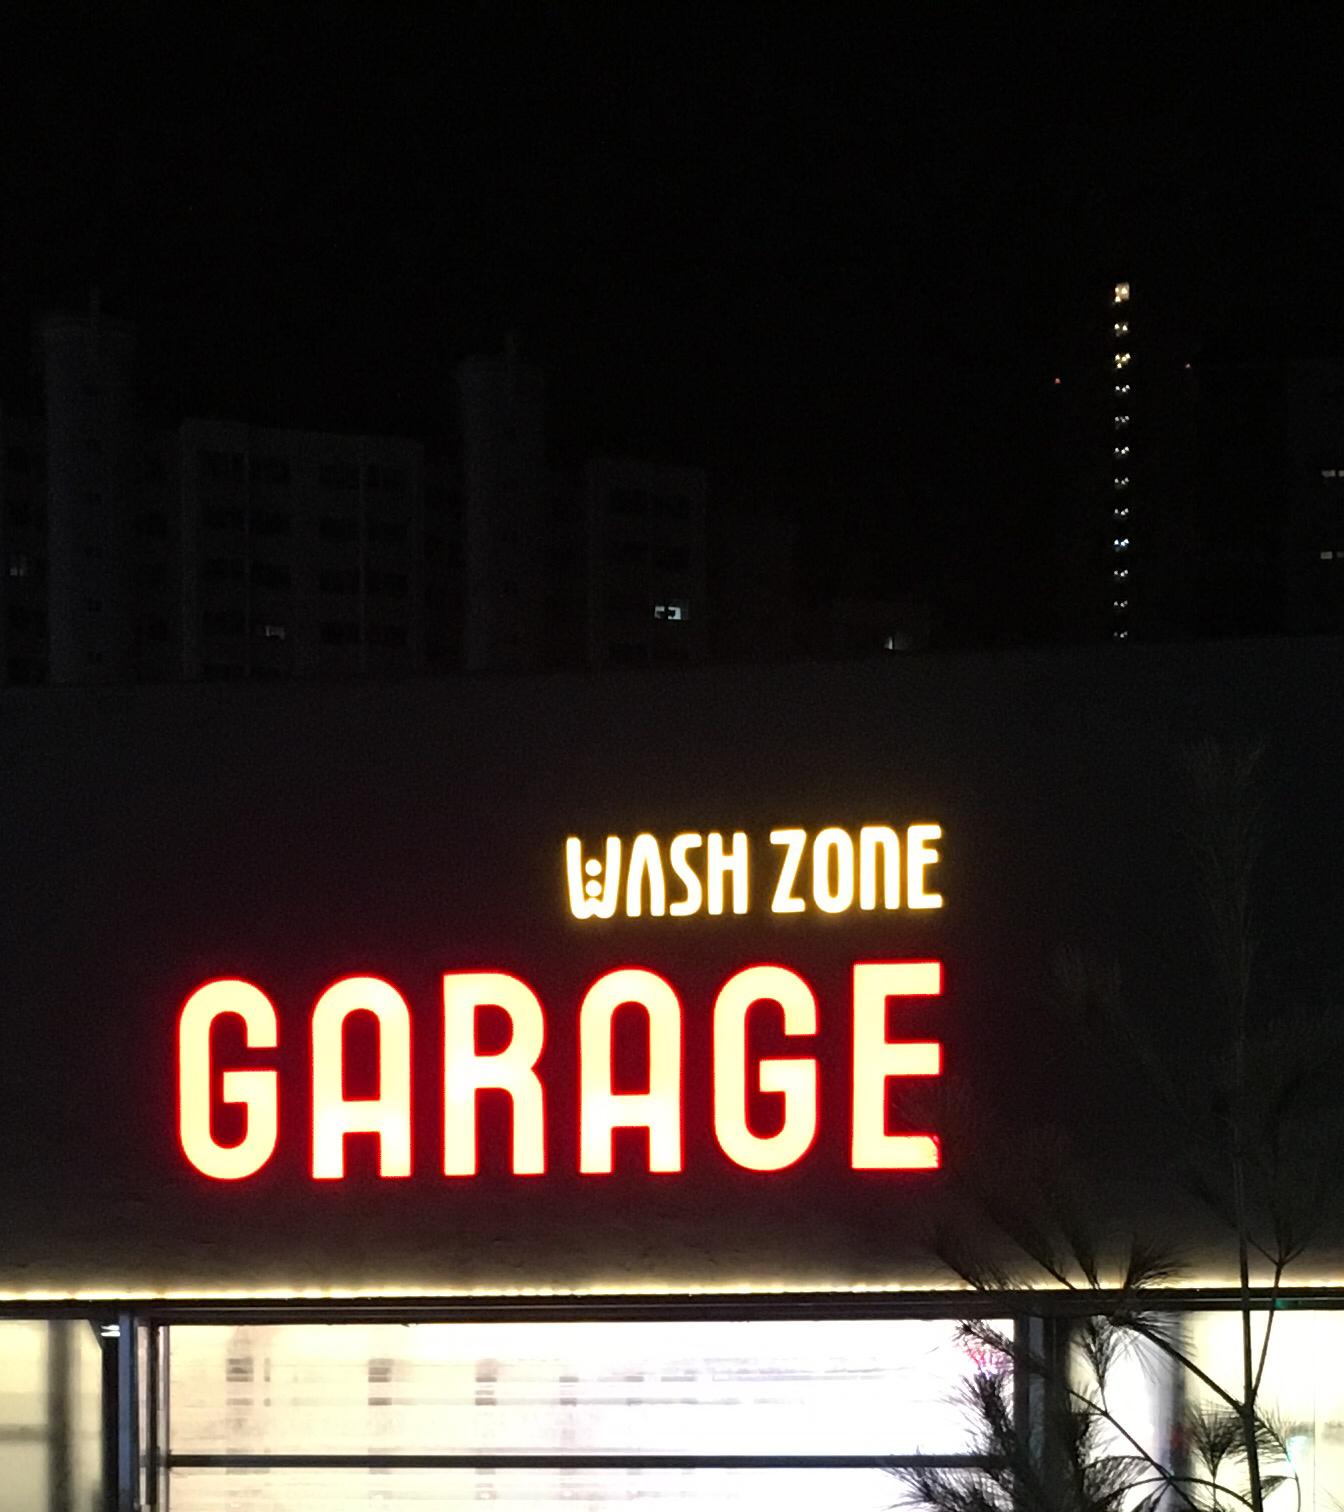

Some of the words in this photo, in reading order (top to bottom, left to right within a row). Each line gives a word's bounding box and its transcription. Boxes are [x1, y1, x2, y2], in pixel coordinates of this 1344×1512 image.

[566, 831, 749, 919] WASH
[769, 823, 943, 914] ZONE
[177, 961, 944, 1181] GARAGE
